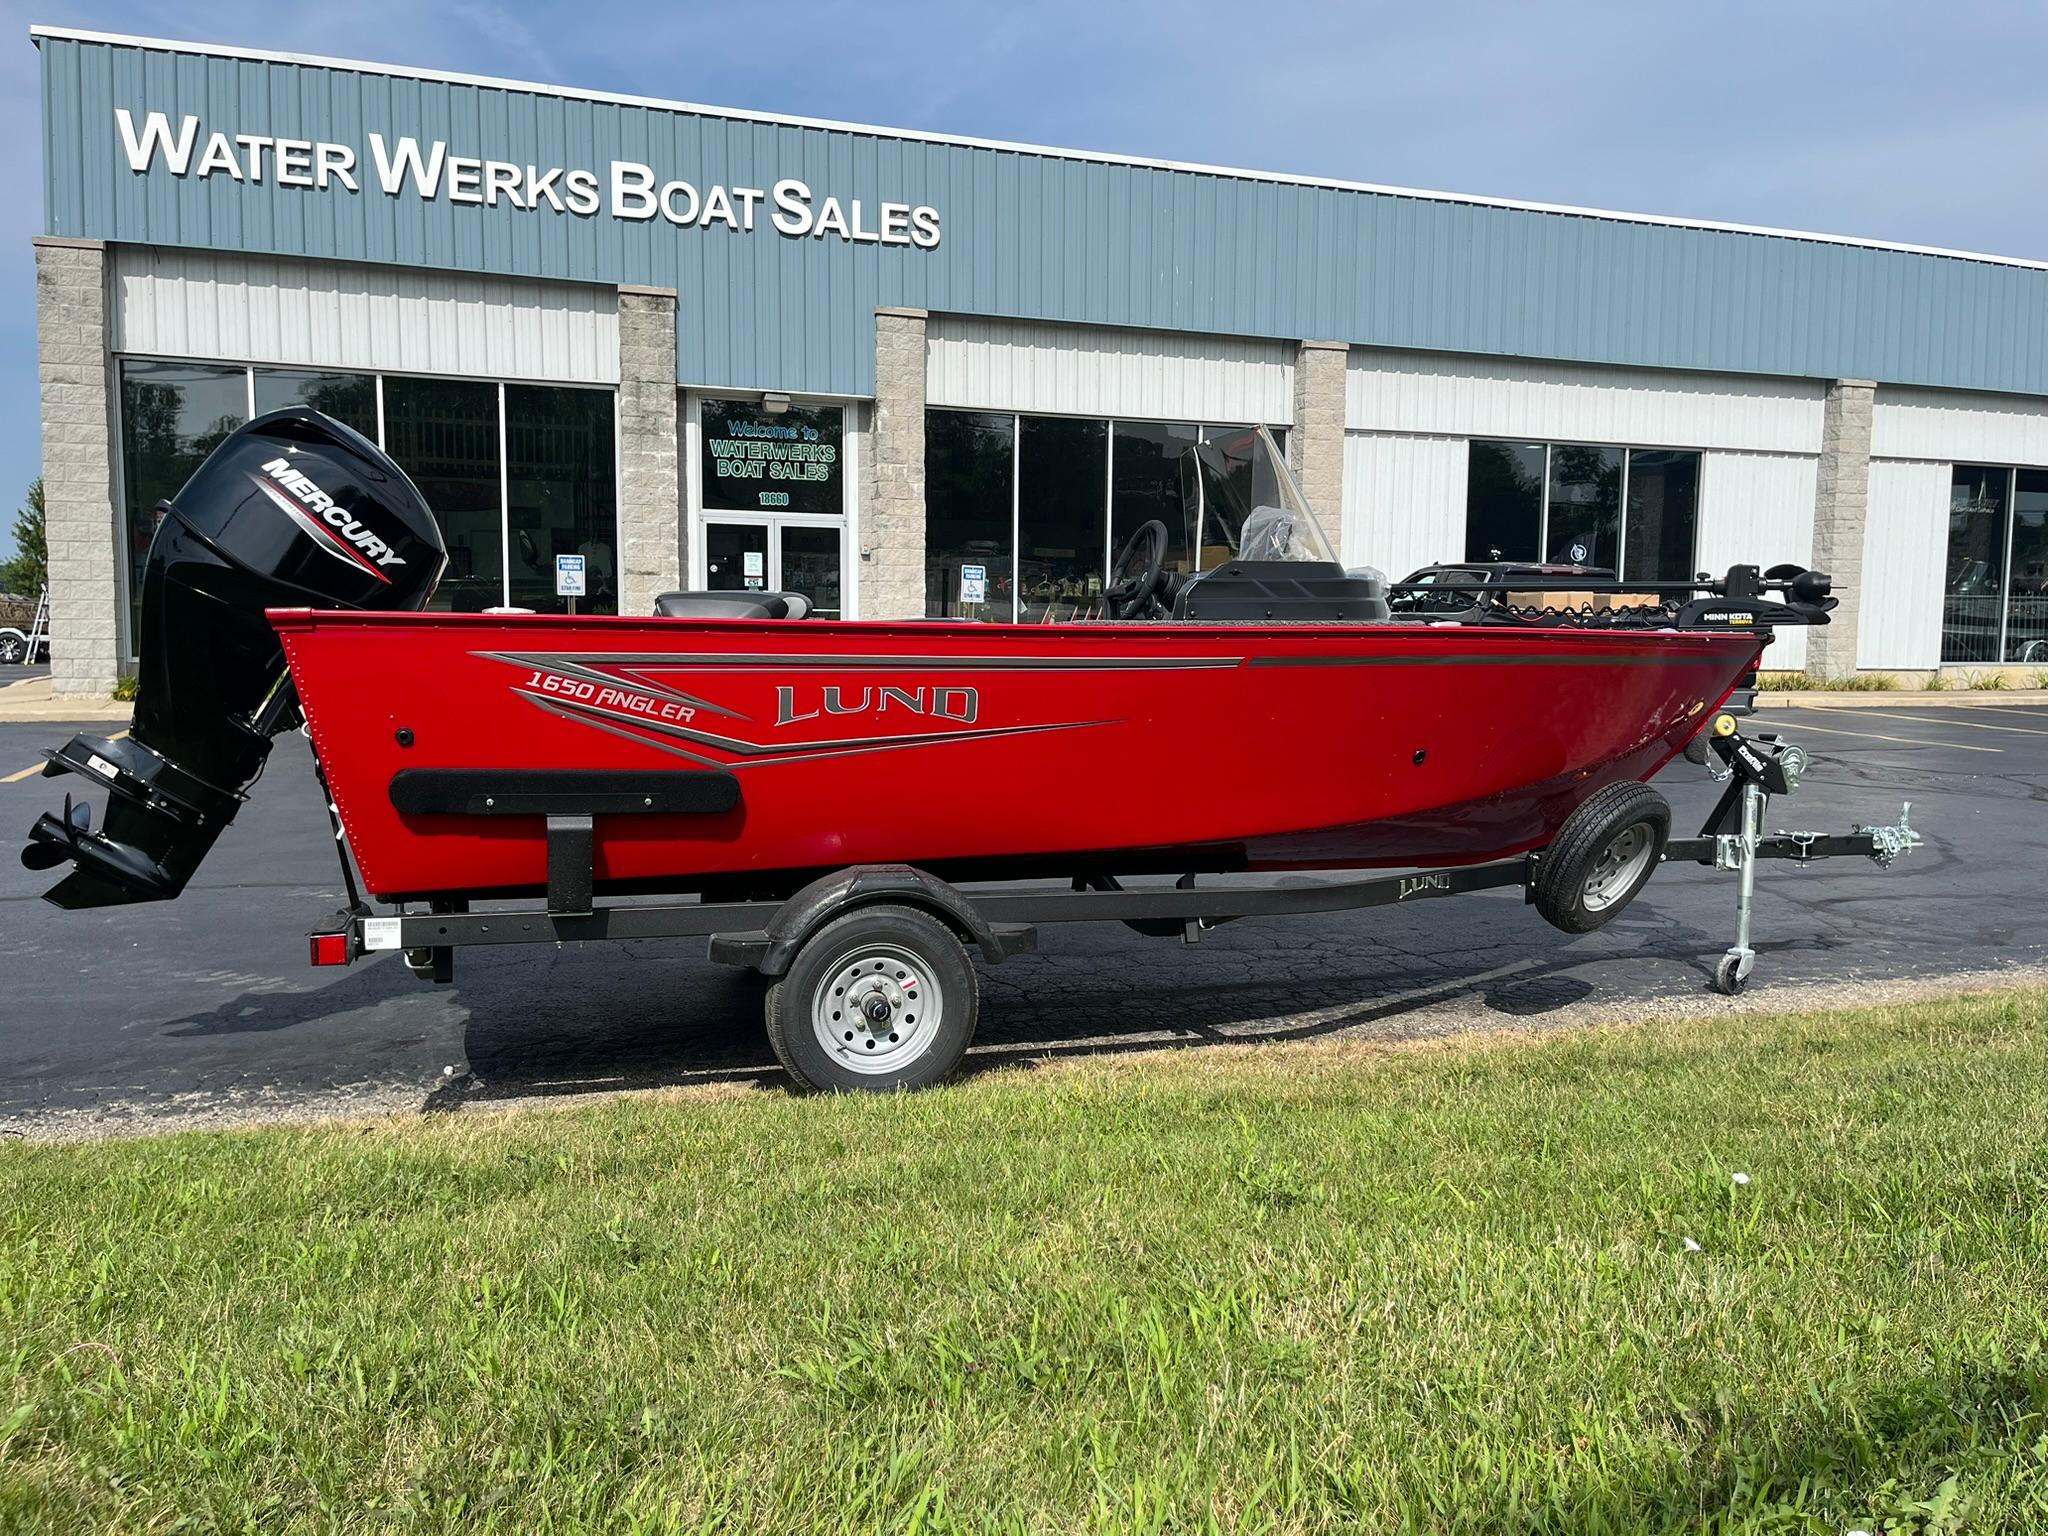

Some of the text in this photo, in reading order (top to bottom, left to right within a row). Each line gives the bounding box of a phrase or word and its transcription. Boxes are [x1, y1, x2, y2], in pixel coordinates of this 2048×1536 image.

[115, 108, 942, 249] WATER WERKS BOAT SALES
[727, 420, 819, 440] Welcome to
[709, 439, 836, 462] WATERWERKS
[717, 459, 829, 481] BOAT SALES
[759, 492, 789, 506] 18660
[261, 457, 407, 566] MERCURY
[1703, 612, 1753, 621] MINN KOTA
[525, 671, 697, 723] 1650 ANGLER
[774, 686, 979, 727] LUND
[1398, 873, 1450, 899] LUND
